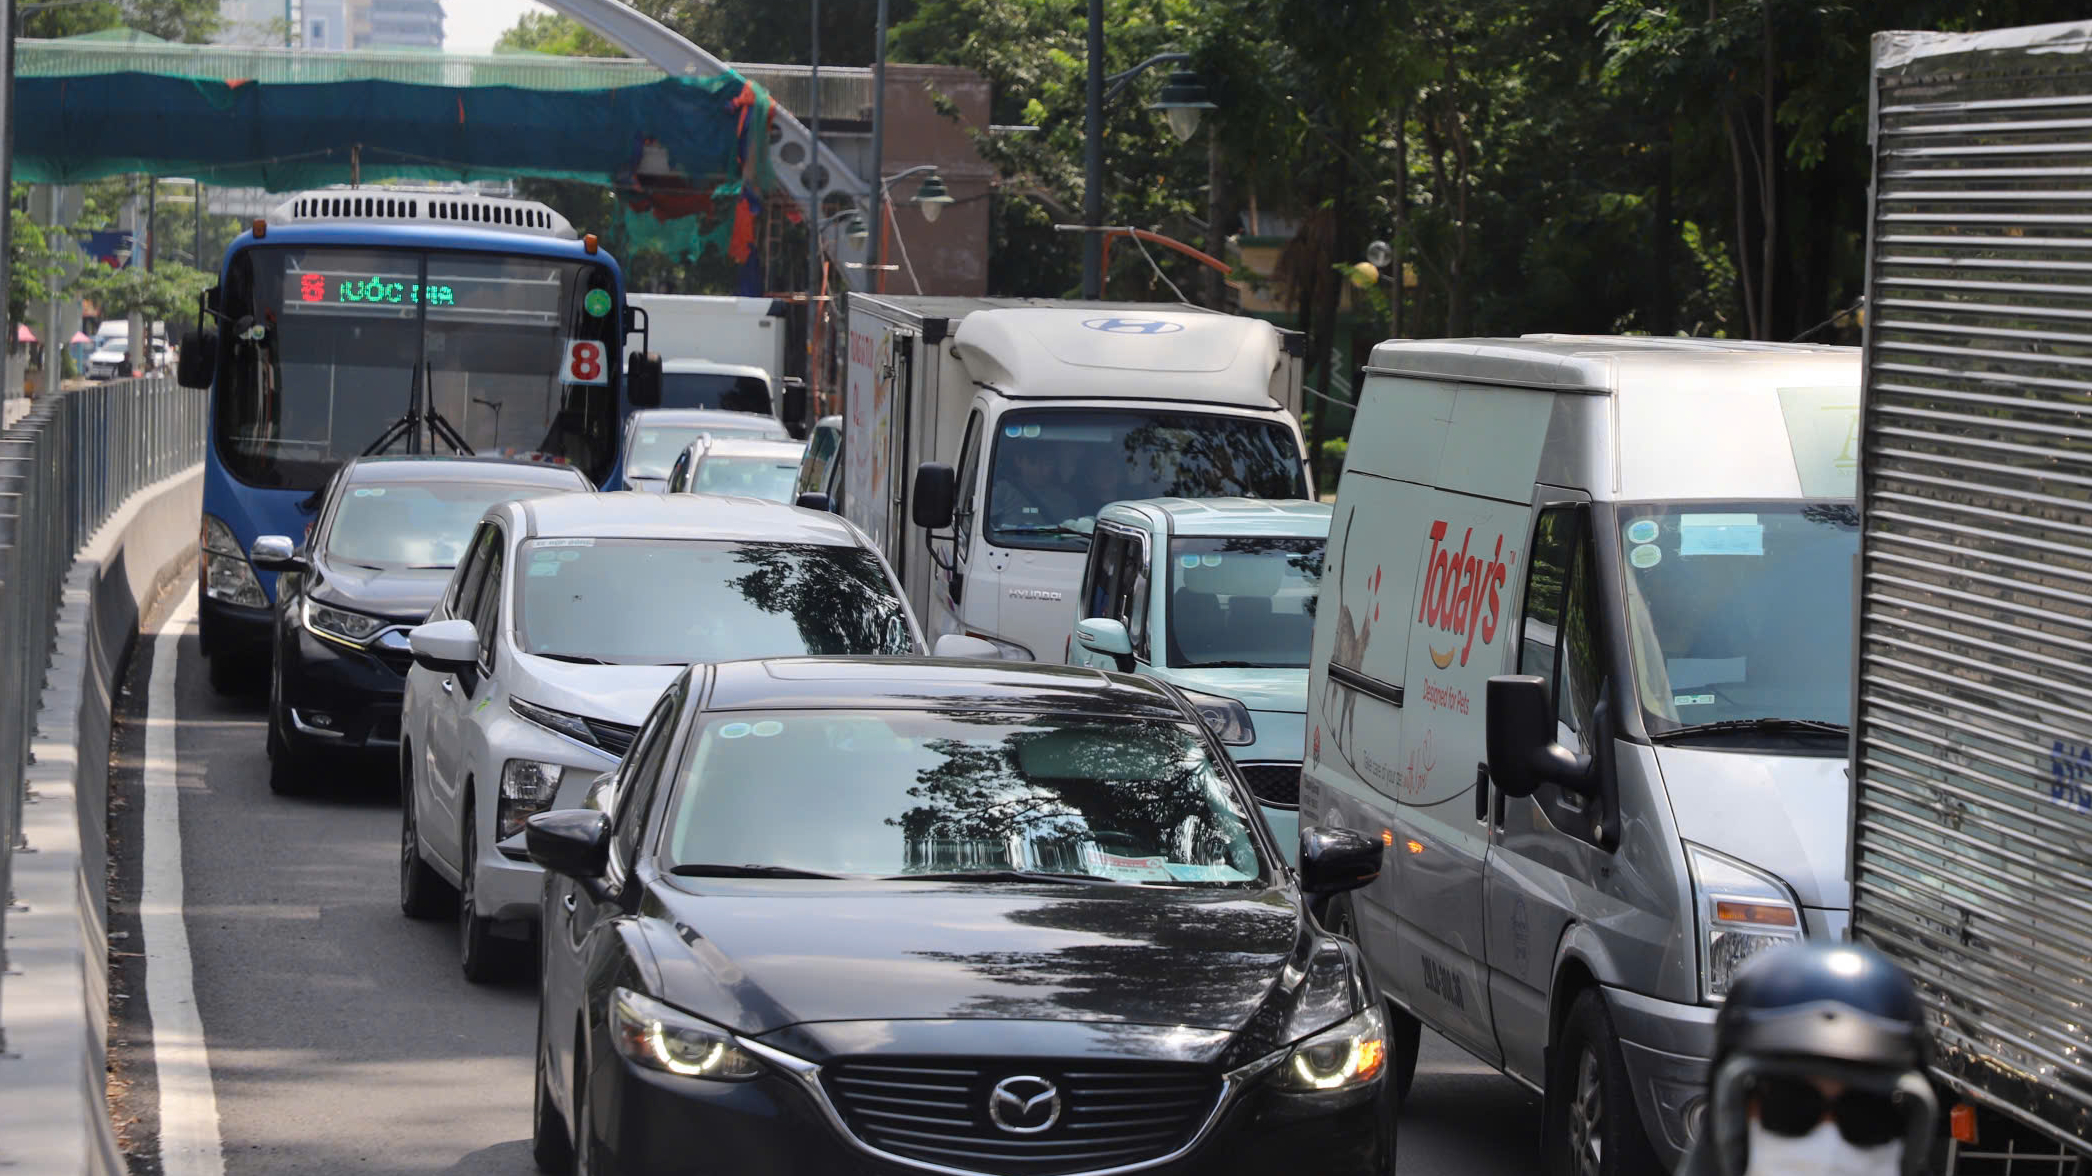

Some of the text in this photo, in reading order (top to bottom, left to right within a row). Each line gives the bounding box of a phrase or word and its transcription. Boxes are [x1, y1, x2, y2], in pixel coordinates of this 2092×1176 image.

[571, 342, 601, 380] 8
[1008, 588, 1062, 601] HYUNDAI
[1418, 520, 1507, 667] Today's
[1422, 676, 1470, 716] Designed for Pets
